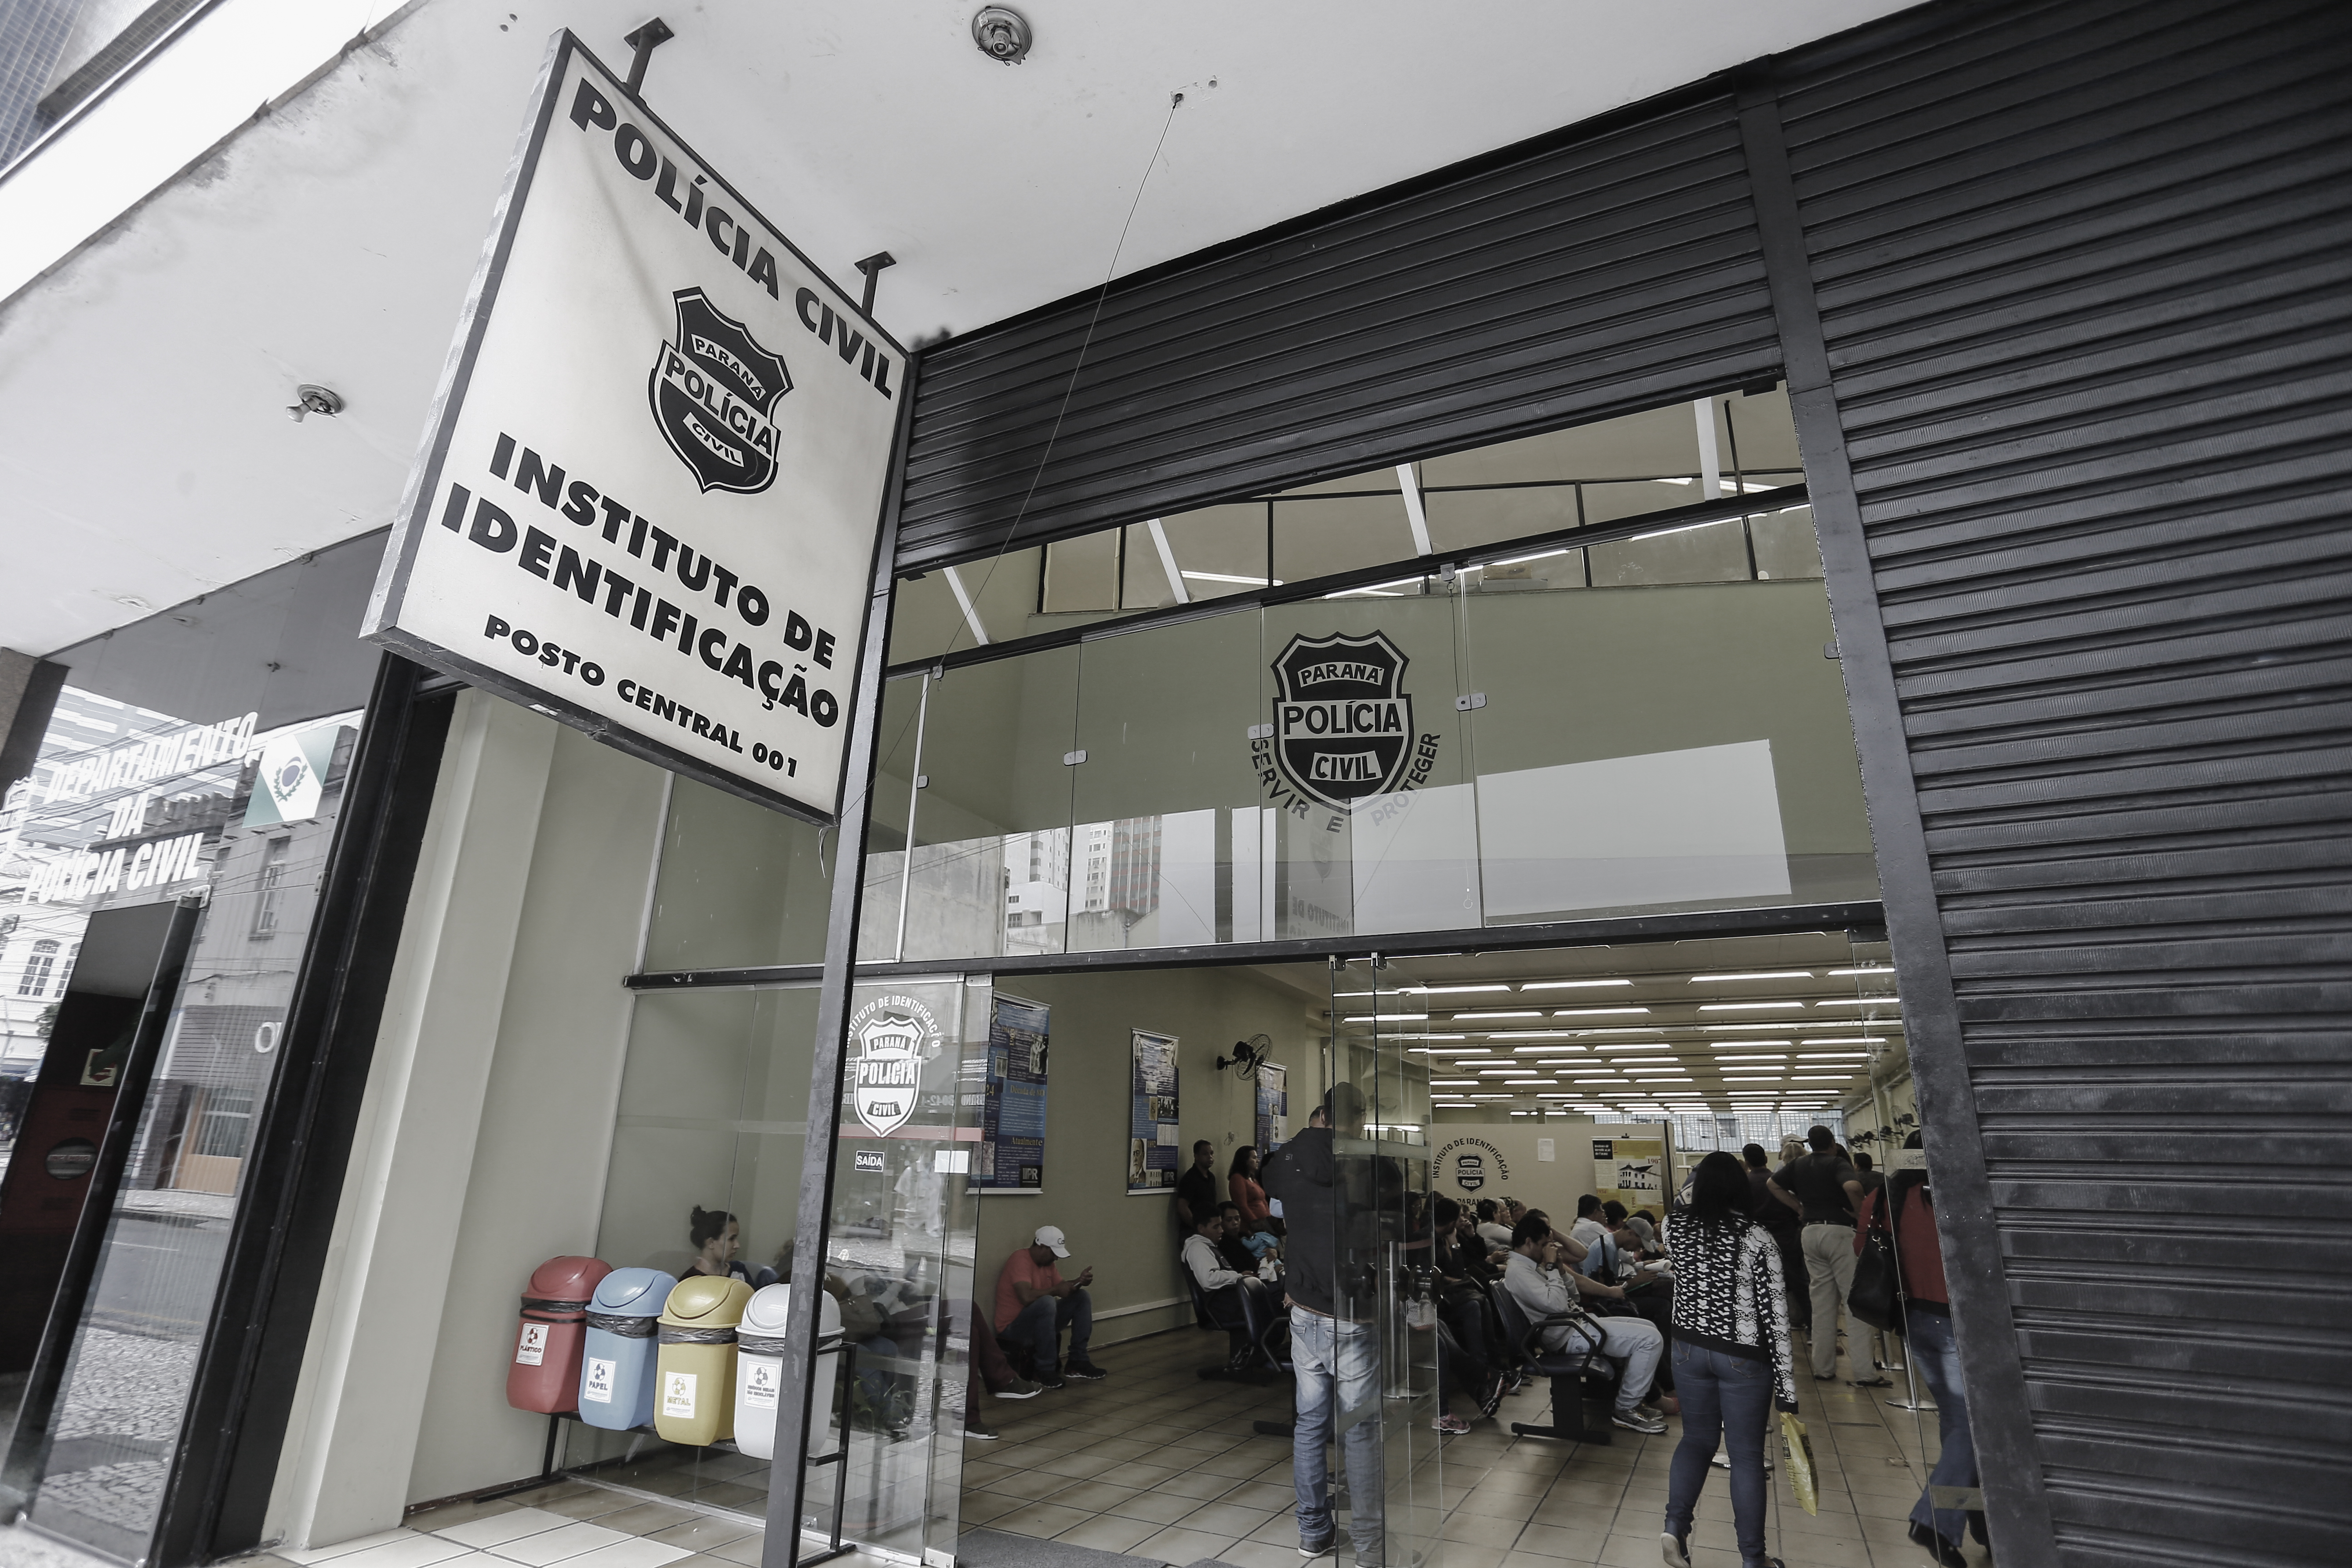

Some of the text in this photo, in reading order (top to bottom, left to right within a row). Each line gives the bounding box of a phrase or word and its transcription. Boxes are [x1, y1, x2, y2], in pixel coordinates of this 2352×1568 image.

[570, 77, 892, 400] POLÍCIA CIVIL
[695, 339, 765, 398] PARANÁ
[665, 351, 772, 456] POLÍCIA
[692, 423, 741, 464] CIVIL
[490, 431, 835, 670] INSTITUTO DE
[441, 482, 838, 727] IDENTIFICAÇÃO
[1300, 664, 1383, 685] PARANÁ
[485, 613, 798, 778] POSTO CENTRAL 001
[1284, 700, 1403, 735] POLÍCIA
[43, 711, 258, 805] DEPARTAMENTO
[1315, 755, 1377, 780] CIVIL
[1251, 731, 1441, 833] SERVIR E PROTEGER
[106, 792, 149, 840] DA
[20, 832, 205, 906] POLÍCIA CIVIL
[878, 996, 889, 1009] DE
[873, 1036, 906, 1050] PARANÁ
[872, 1102, 897, 1116] CIVIL
[856, 1154, 883, 1167] SAÍDA
[1011, 1137, 1043, 1147] Atualmente
[1432, 1138, 1510, 1180] INSTITUTO DE IDENTIFICAÇÃO
[588, 1380, 608, 1391] PAPEL
[667, 1395, 691, 1406] METAL
